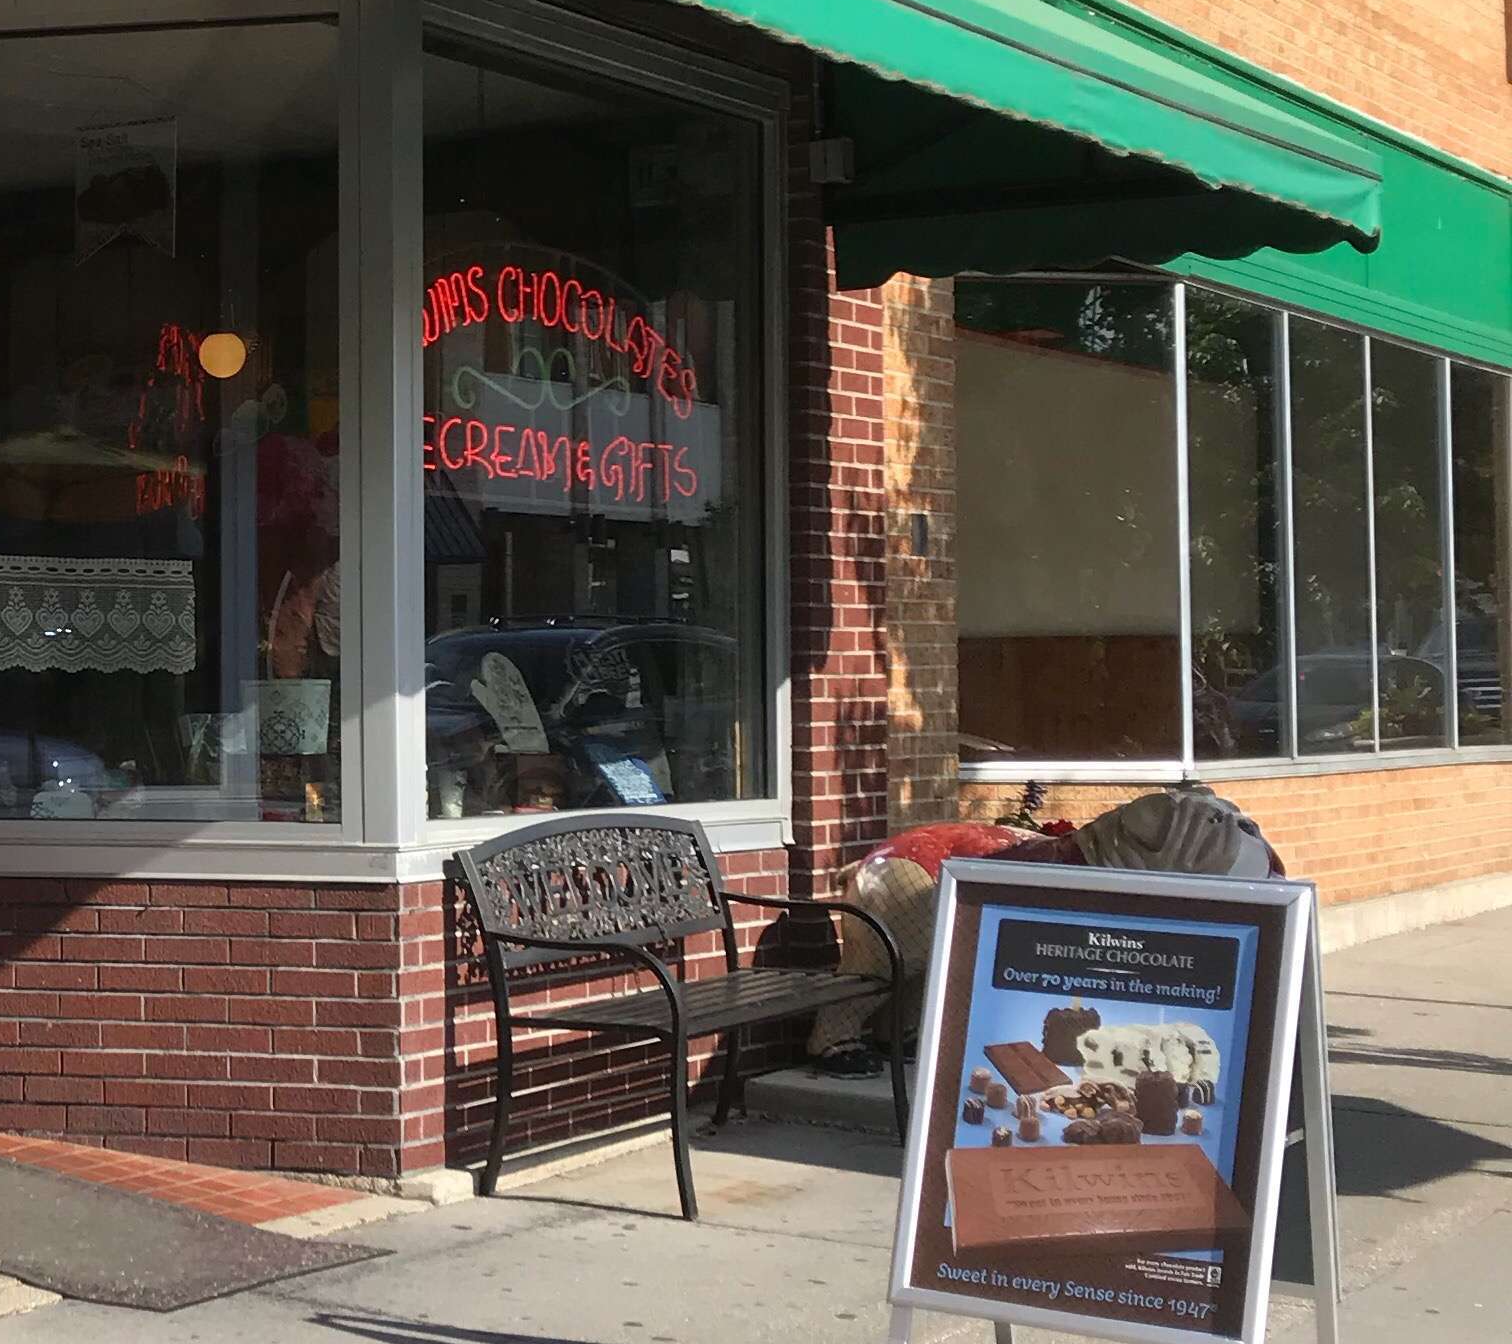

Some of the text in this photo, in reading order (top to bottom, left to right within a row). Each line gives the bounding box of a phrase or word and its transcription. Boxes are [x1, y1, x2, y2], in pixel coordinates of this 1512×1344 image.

[497, 265, 697, 420] CHOCOLATES
[1036, 942, 1195, 969] HERITAGE CHOCOLATE
[1088, 931, 1145, 951] Kilwins
[1003, 967, 1221, 1005] Over 70 years in the making!
[935, 1262, 988, 1285] Sweet
[990, 1269, 1009, 1288] in
[1011, 1276, 1061, 1300] every
[1064, 1280, 1116, 1303] Sense
[1117, 1288, 1164, 1311] since
